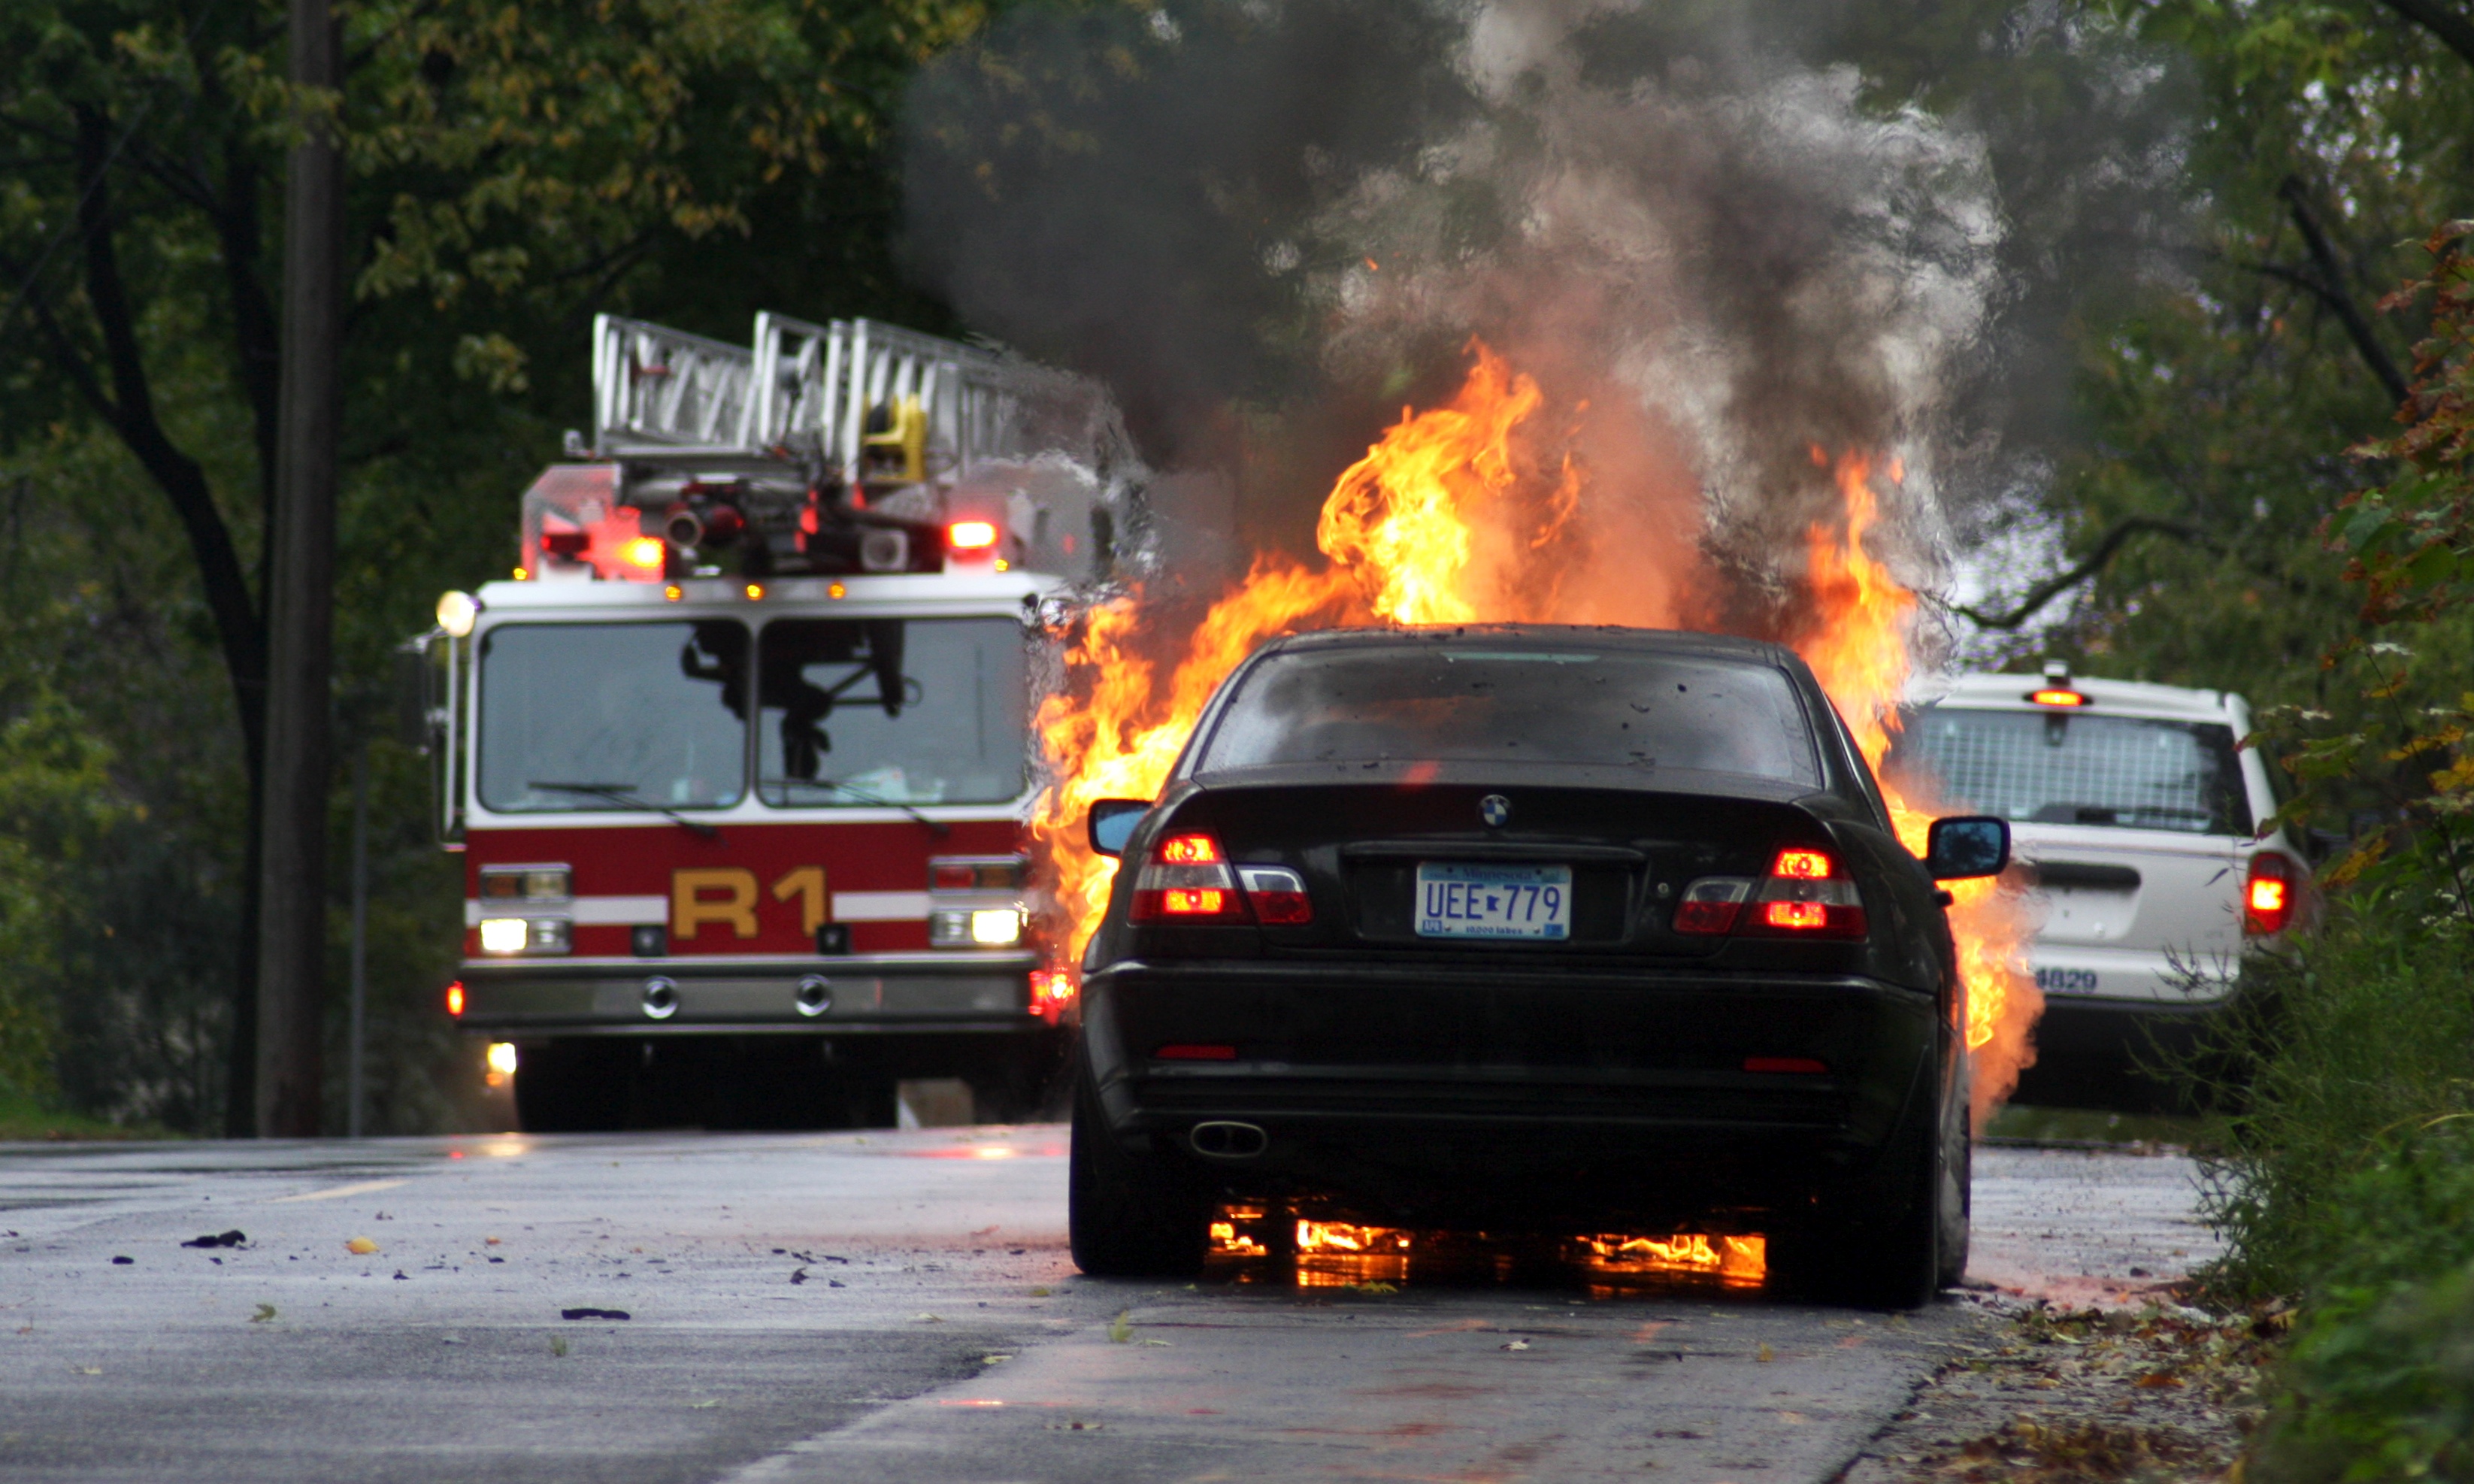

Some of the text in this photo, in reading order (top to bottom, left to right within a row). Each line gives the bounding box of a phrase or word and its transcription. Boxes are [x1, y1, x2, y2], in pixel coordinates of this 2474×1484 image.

[673, 867, 825, 937] R1
[1427, 883, 1561, 922] UEE 779
